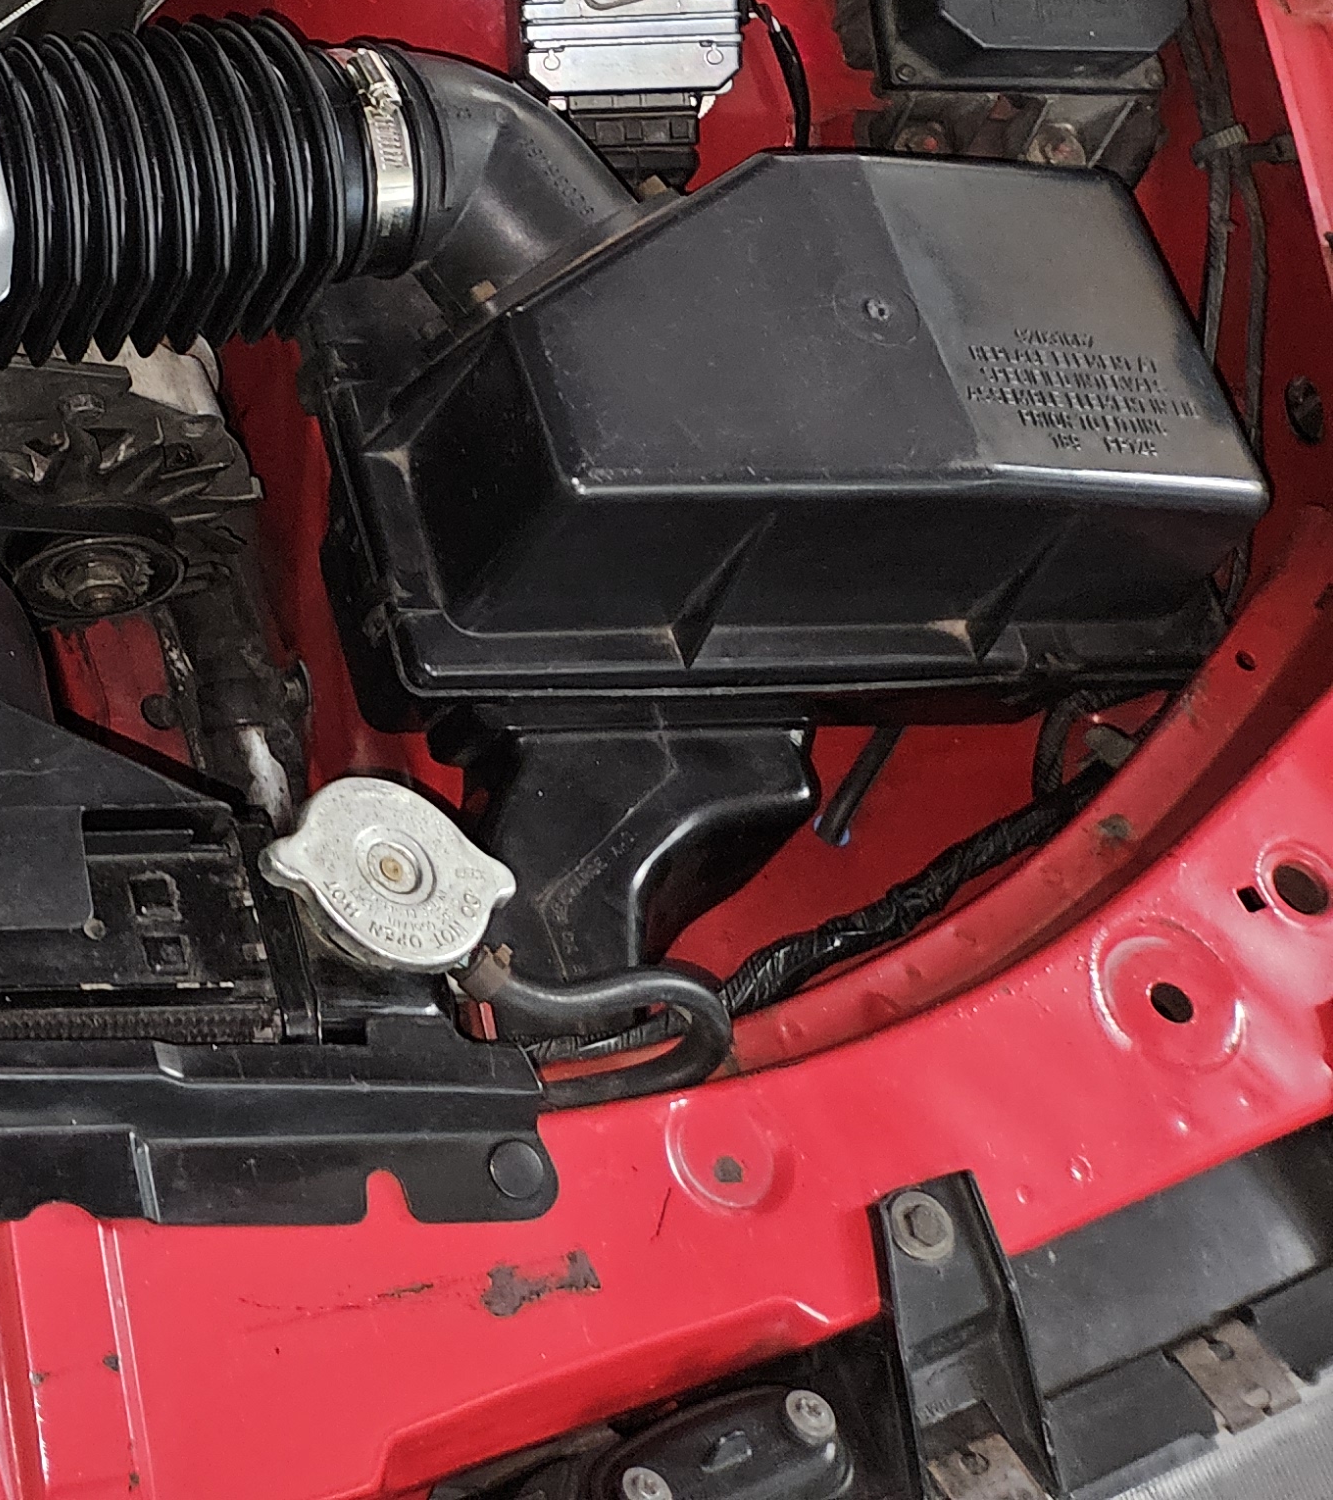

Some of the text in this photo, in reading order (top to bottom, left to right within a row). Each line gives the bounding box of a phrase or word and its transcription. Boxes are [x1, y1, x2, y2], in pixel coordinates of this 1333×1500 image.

[1017, 408, 1076, 430] PRIOR
[323, 879, 363, 918] HOT
[368, 920, 424, 949] OPEN
[433, 918, 470, 950] NOT
